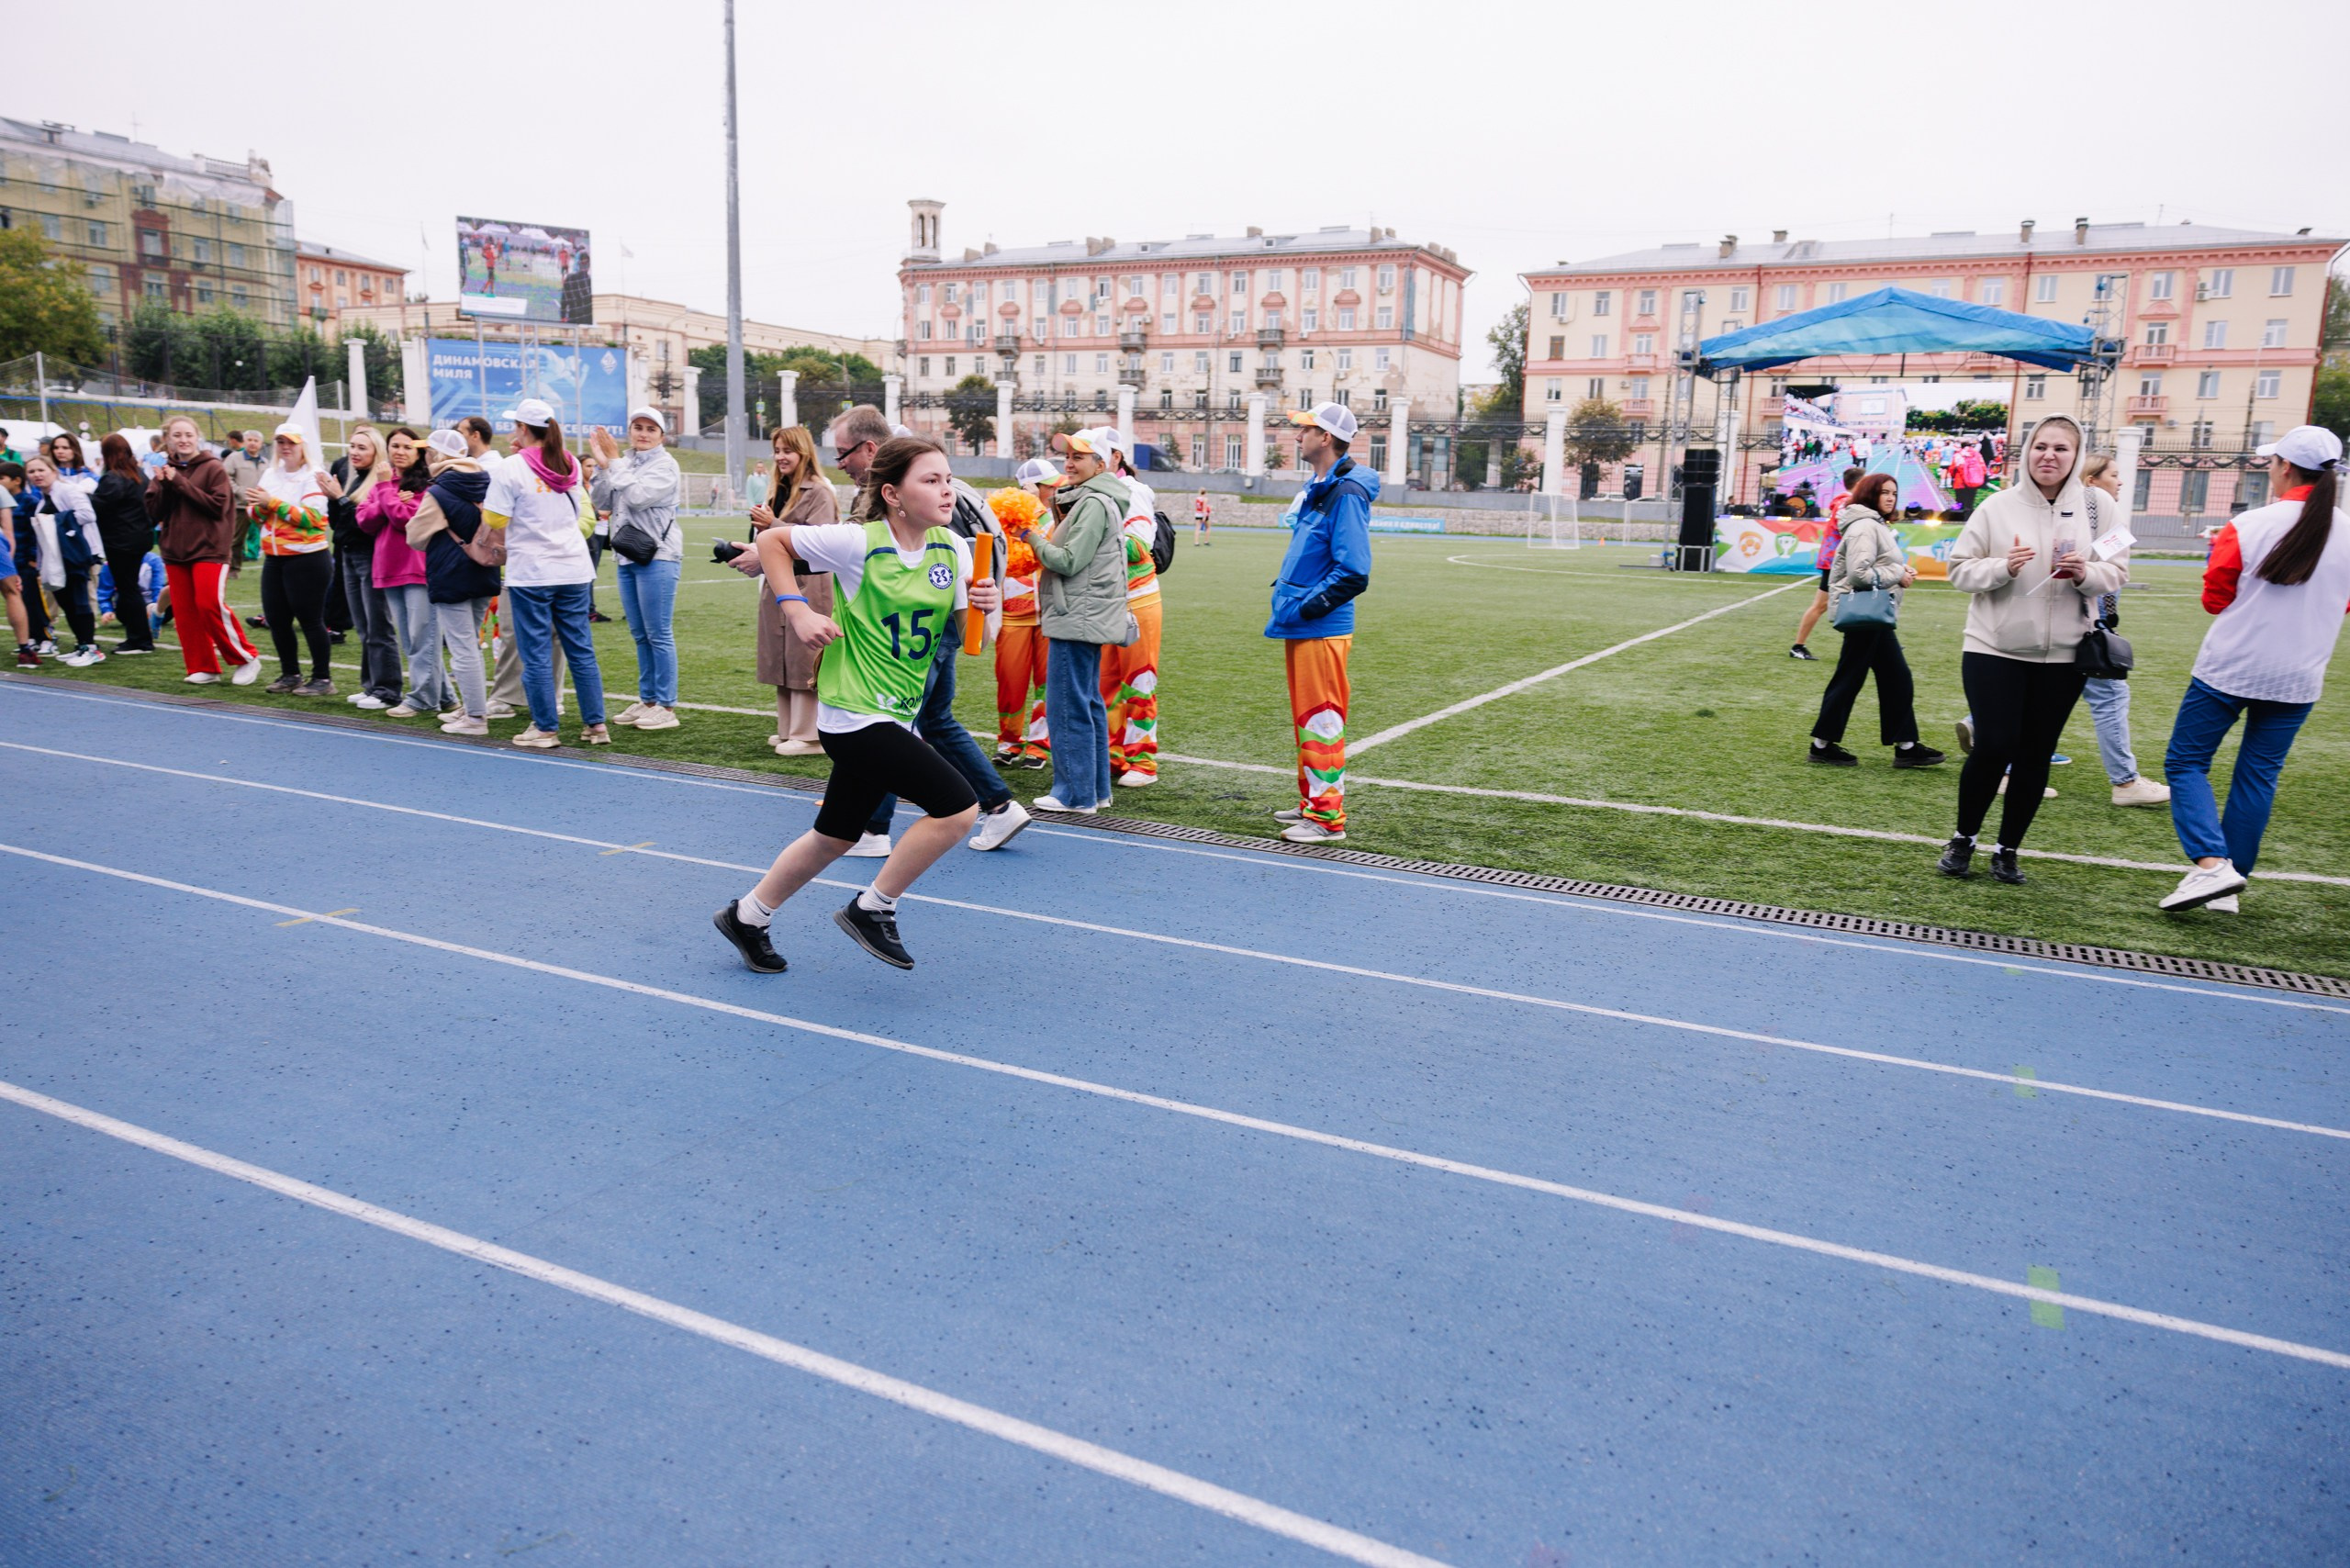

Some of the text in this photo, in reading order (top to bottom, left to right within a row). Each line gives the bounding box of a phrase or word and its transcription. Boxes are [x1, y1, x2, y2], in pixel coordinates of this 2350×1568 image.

[433, 354, 537, 369] ДИНАМОВСКАЯ
[432, 368, 473, 379] МИЛЯ
[881, 609, 934, 660] 15
